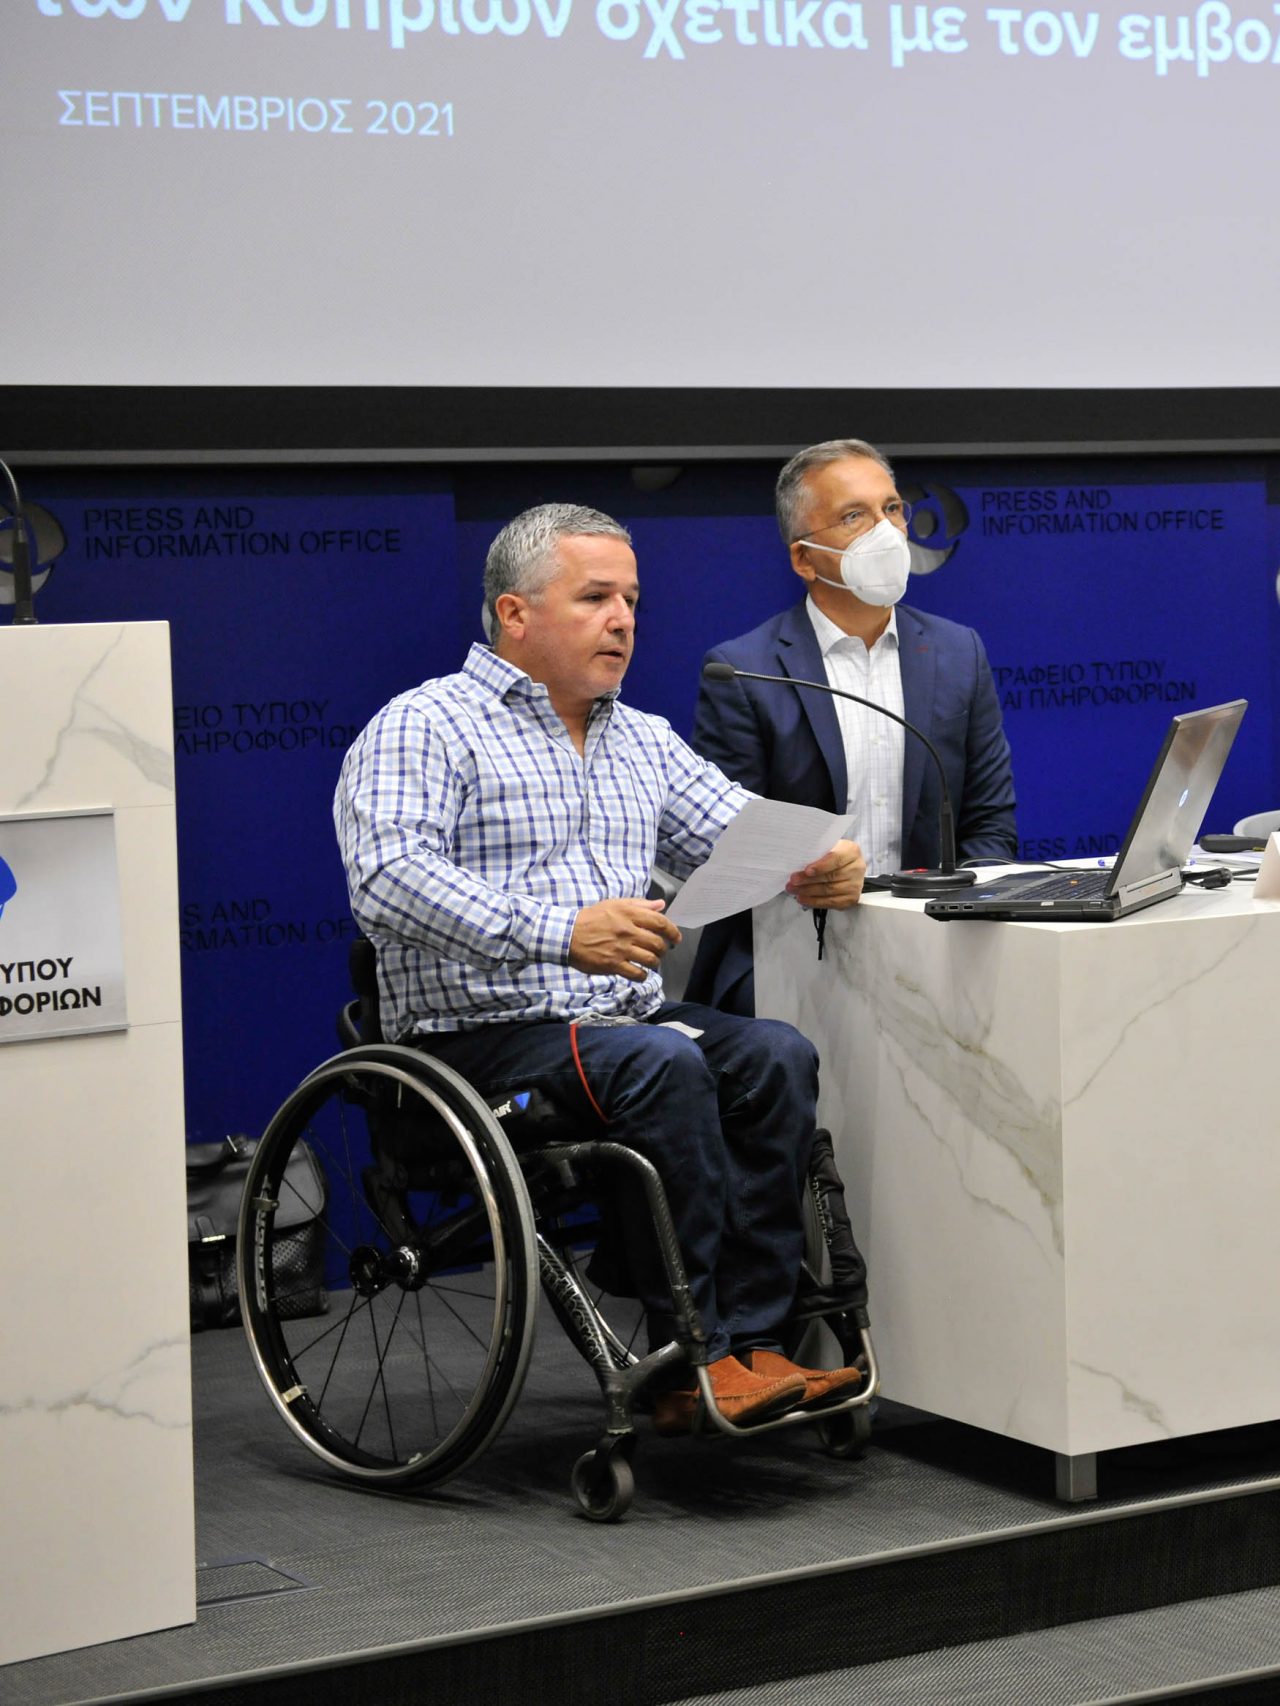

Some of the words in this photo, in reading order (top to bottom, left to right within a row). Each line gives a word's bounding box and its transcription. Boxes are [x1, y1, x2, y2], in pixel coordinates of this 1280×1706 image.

[890, 4, 969, 68] με
[987, 8, 1101, 58] τον
[57, 90, 354, 135] ΣΕΠΤΕΜΒΡΙΟΣ
[366, 101, 456, 137] 2021
[982, 490, 1058, 512] PRESS
[1064, 489, 1112, 511] AND
[84, 507, 184, 532] PRESS
[193, 506, 254, 530] AND
[982, 511, 1138, 537] INFORMATION
[1145, 509, 1224, 533] OFFICE
[85, 532, 290, 559] INFORMATION
[300, 529, 401, 554] OFFICE
[1091, 659, 1166, 684] ΤΥΠΟΥ
[1030, 681, 1197, 710] ΠΛΗΡΟΦΟΡΙΩΝ
[233, 699, 329, 726] ΤΥΠΟΥ
[1076, 834, 1120, 856] AND
[211, 899, 270, 924] AND
[0, 957, 74, 984] ΥΠΟΥ
